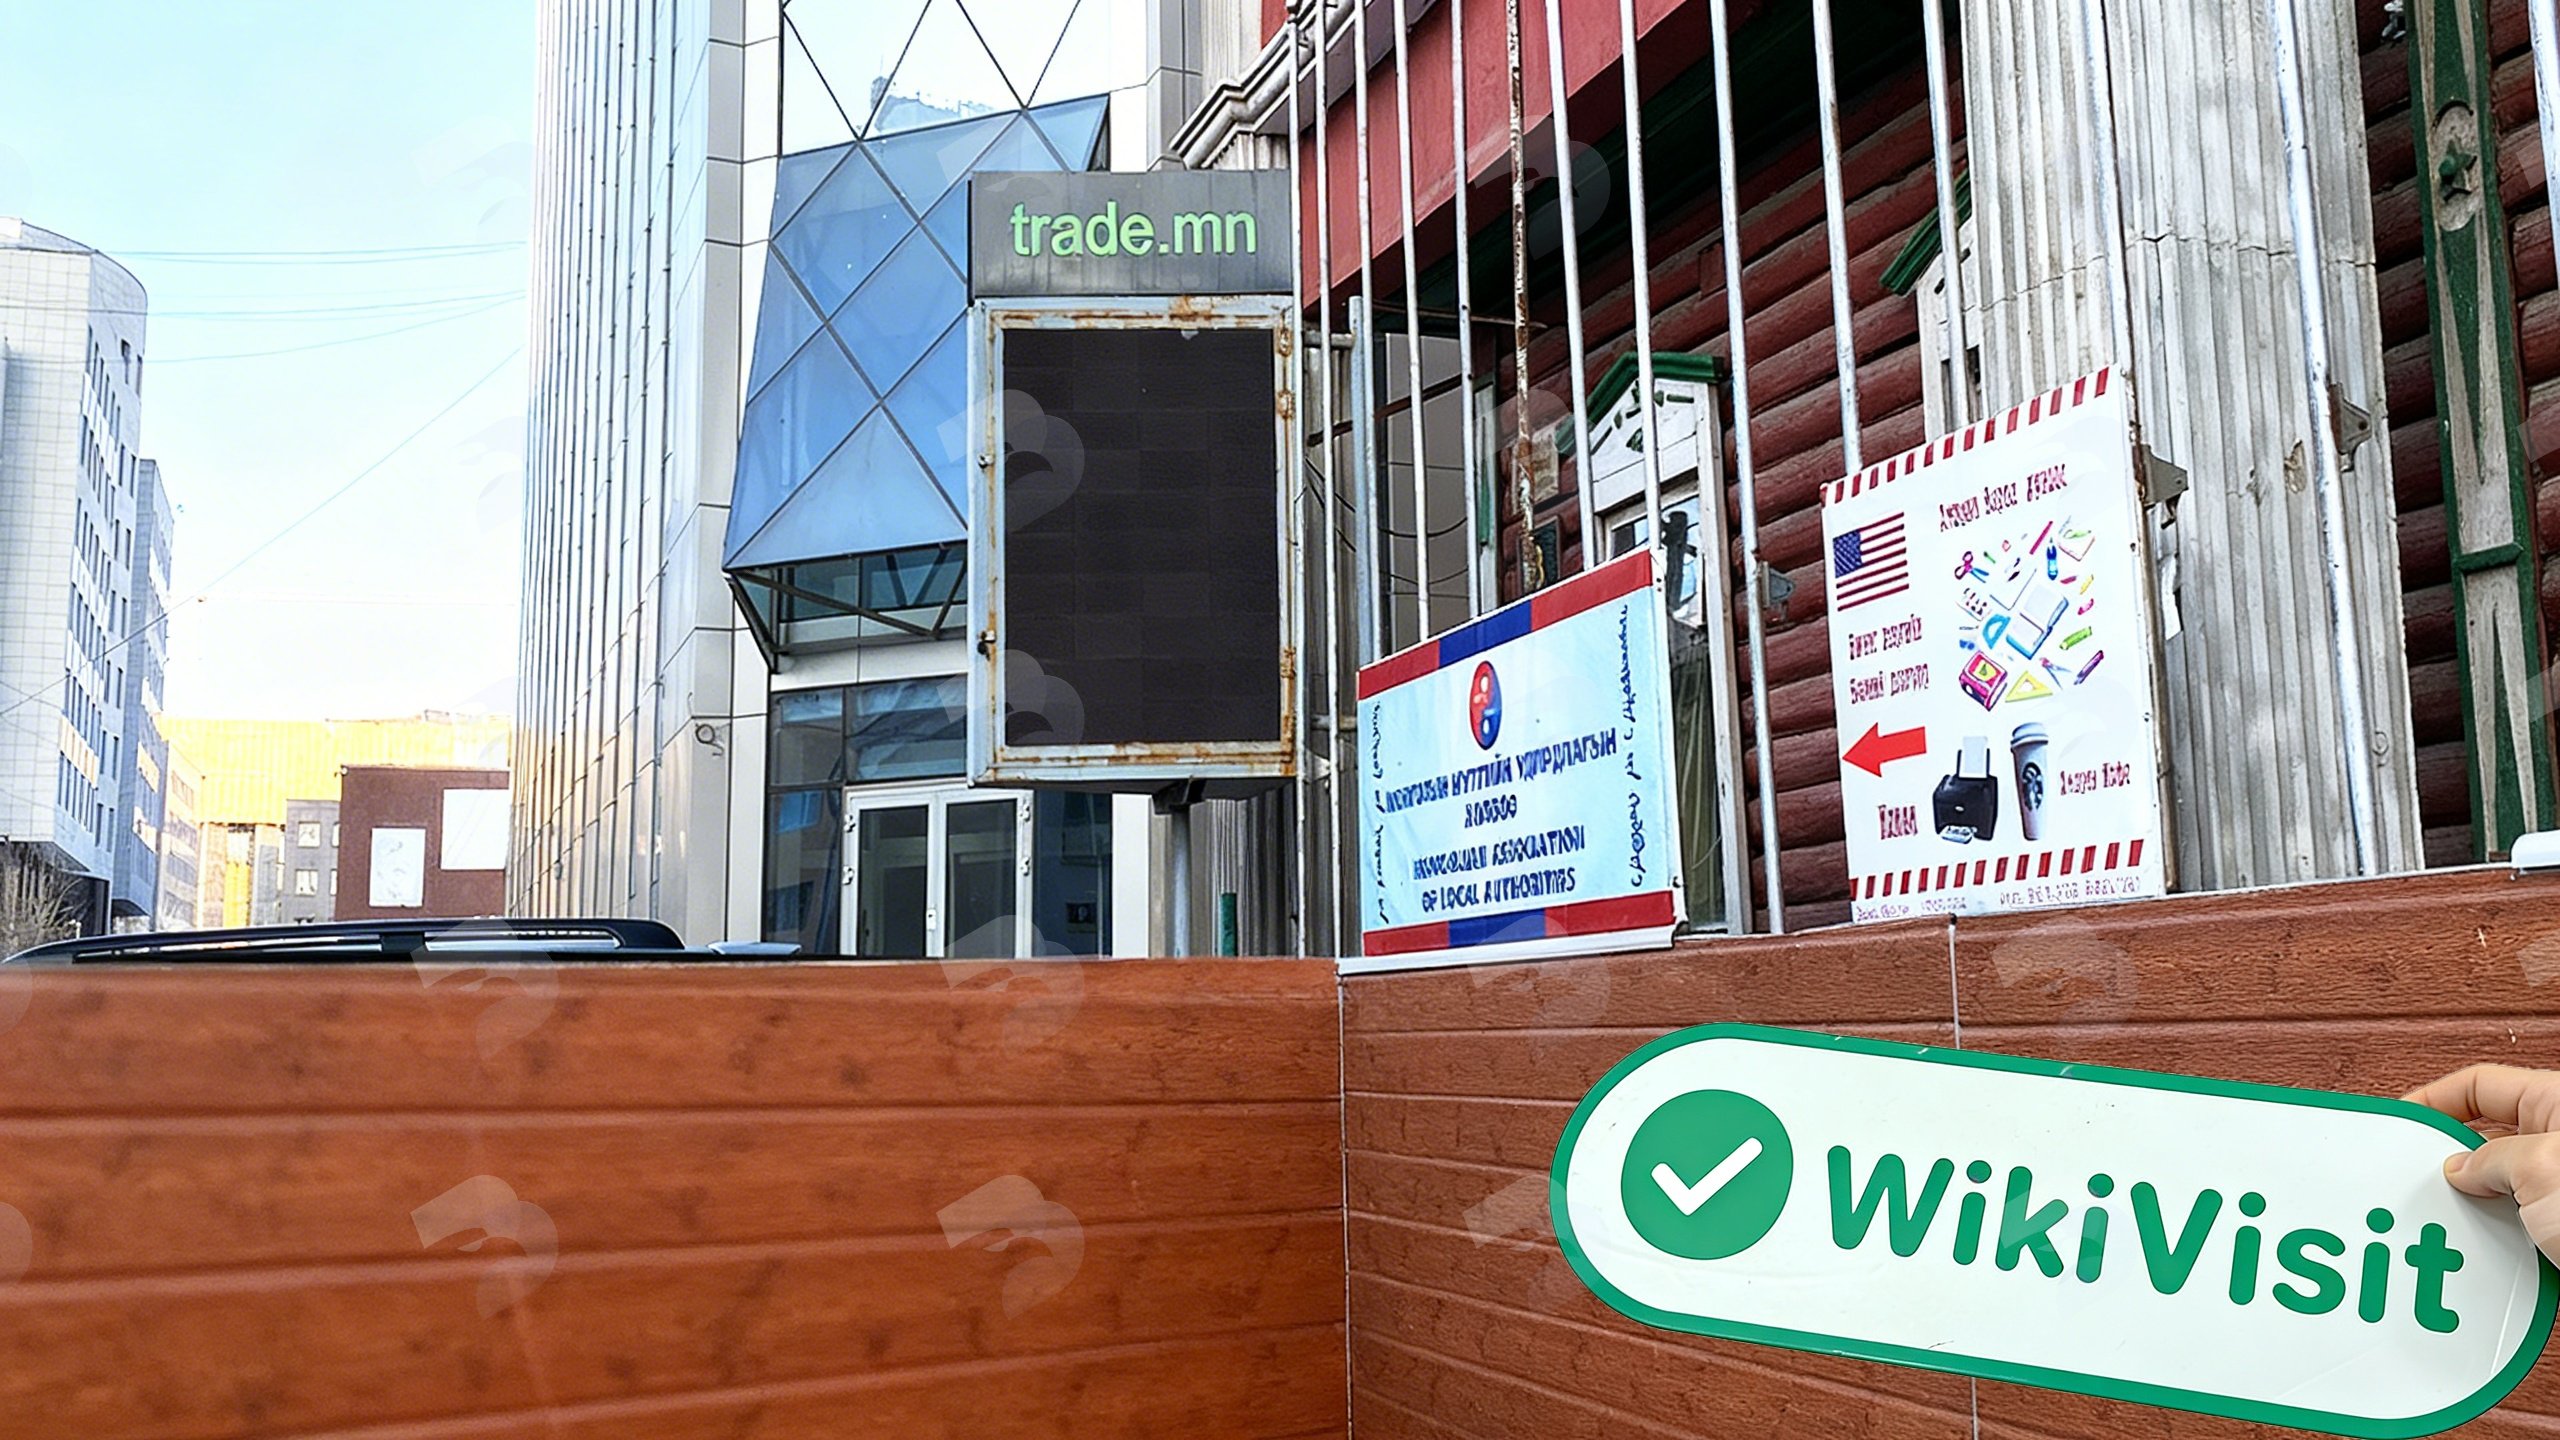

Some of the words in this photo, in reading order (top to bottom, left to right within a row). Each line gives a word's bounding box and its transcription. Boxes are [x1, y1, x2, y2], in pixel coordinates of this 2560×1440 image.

[1010, 199, 1258, 257] trade.mn
[1441, 883, 1479, 910] LOCAL
[1827, 1145, 2464, 1333] WikiVisit
